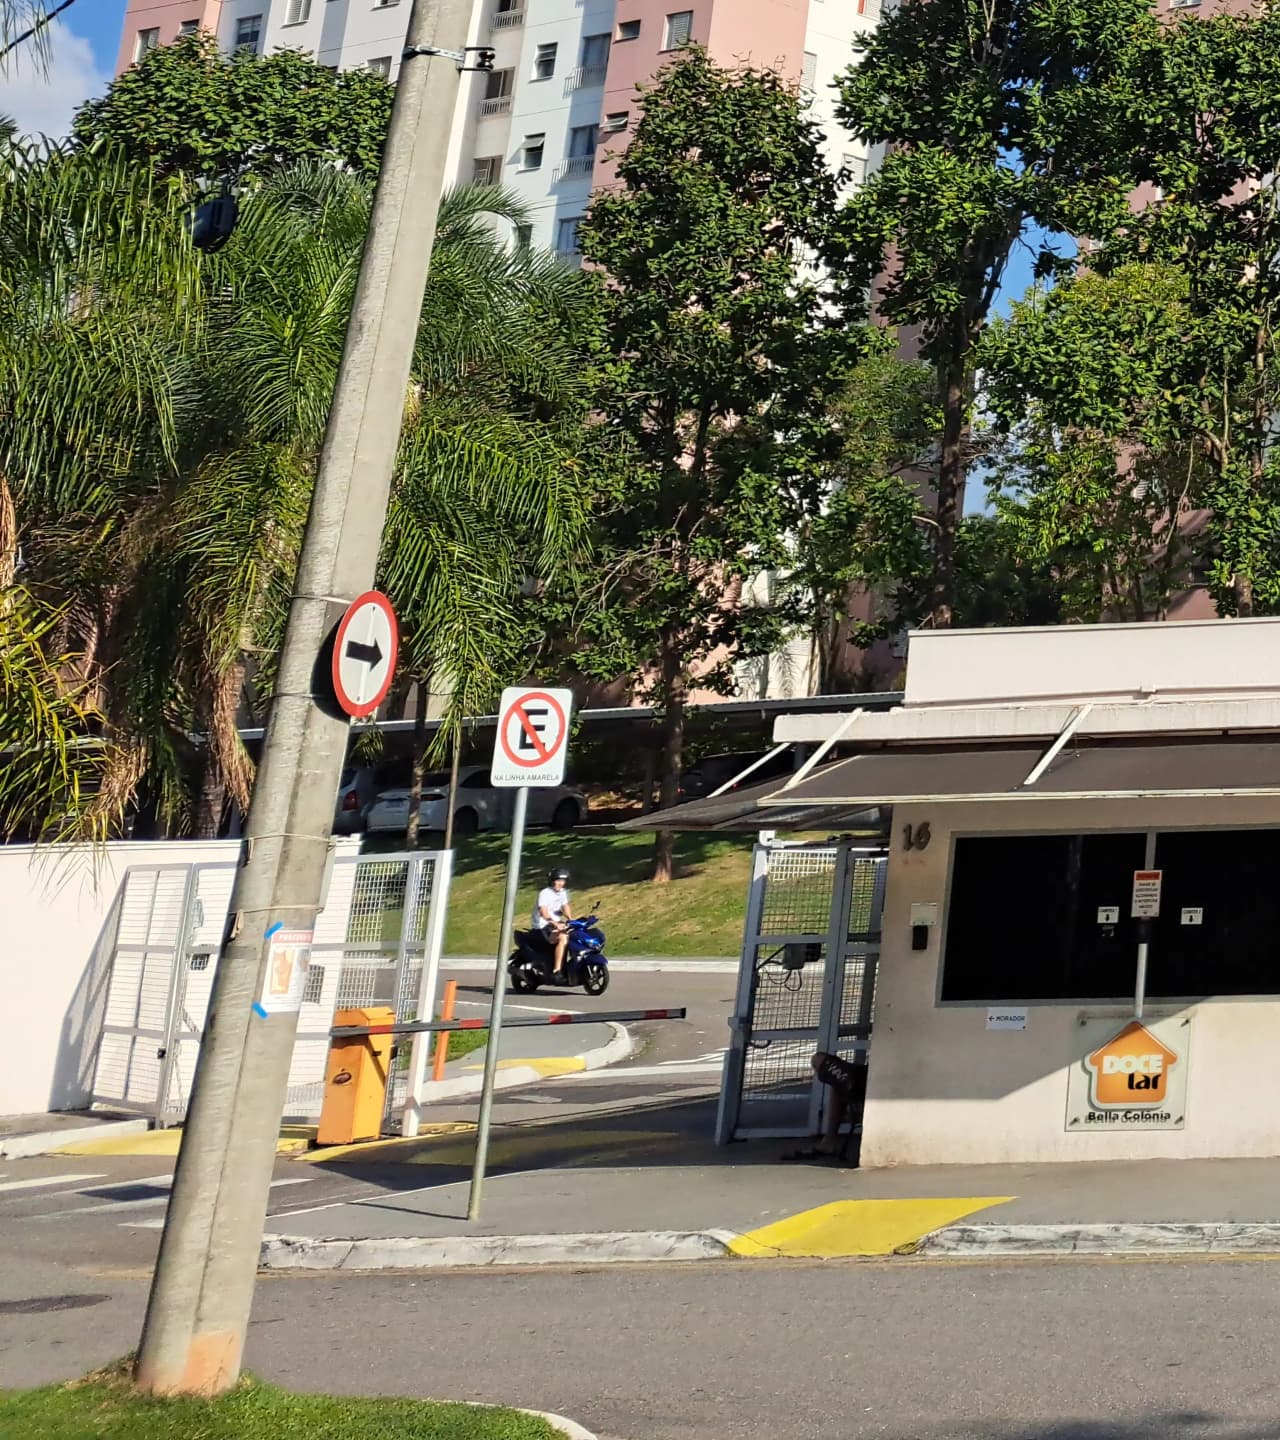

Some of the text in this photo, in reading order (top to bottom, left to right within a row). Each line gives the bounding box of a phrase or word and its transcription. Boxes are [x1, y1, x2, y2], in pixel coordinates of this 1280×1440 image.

[518, 708, 549, 750] E
[903, 821, 931, 851] 16
[1102, 1054, 1163, 1075] DOCE
[1127, 1072, 1162, 1090] lar
[1088, 1110, 1171, 1121] Bella Colônia
